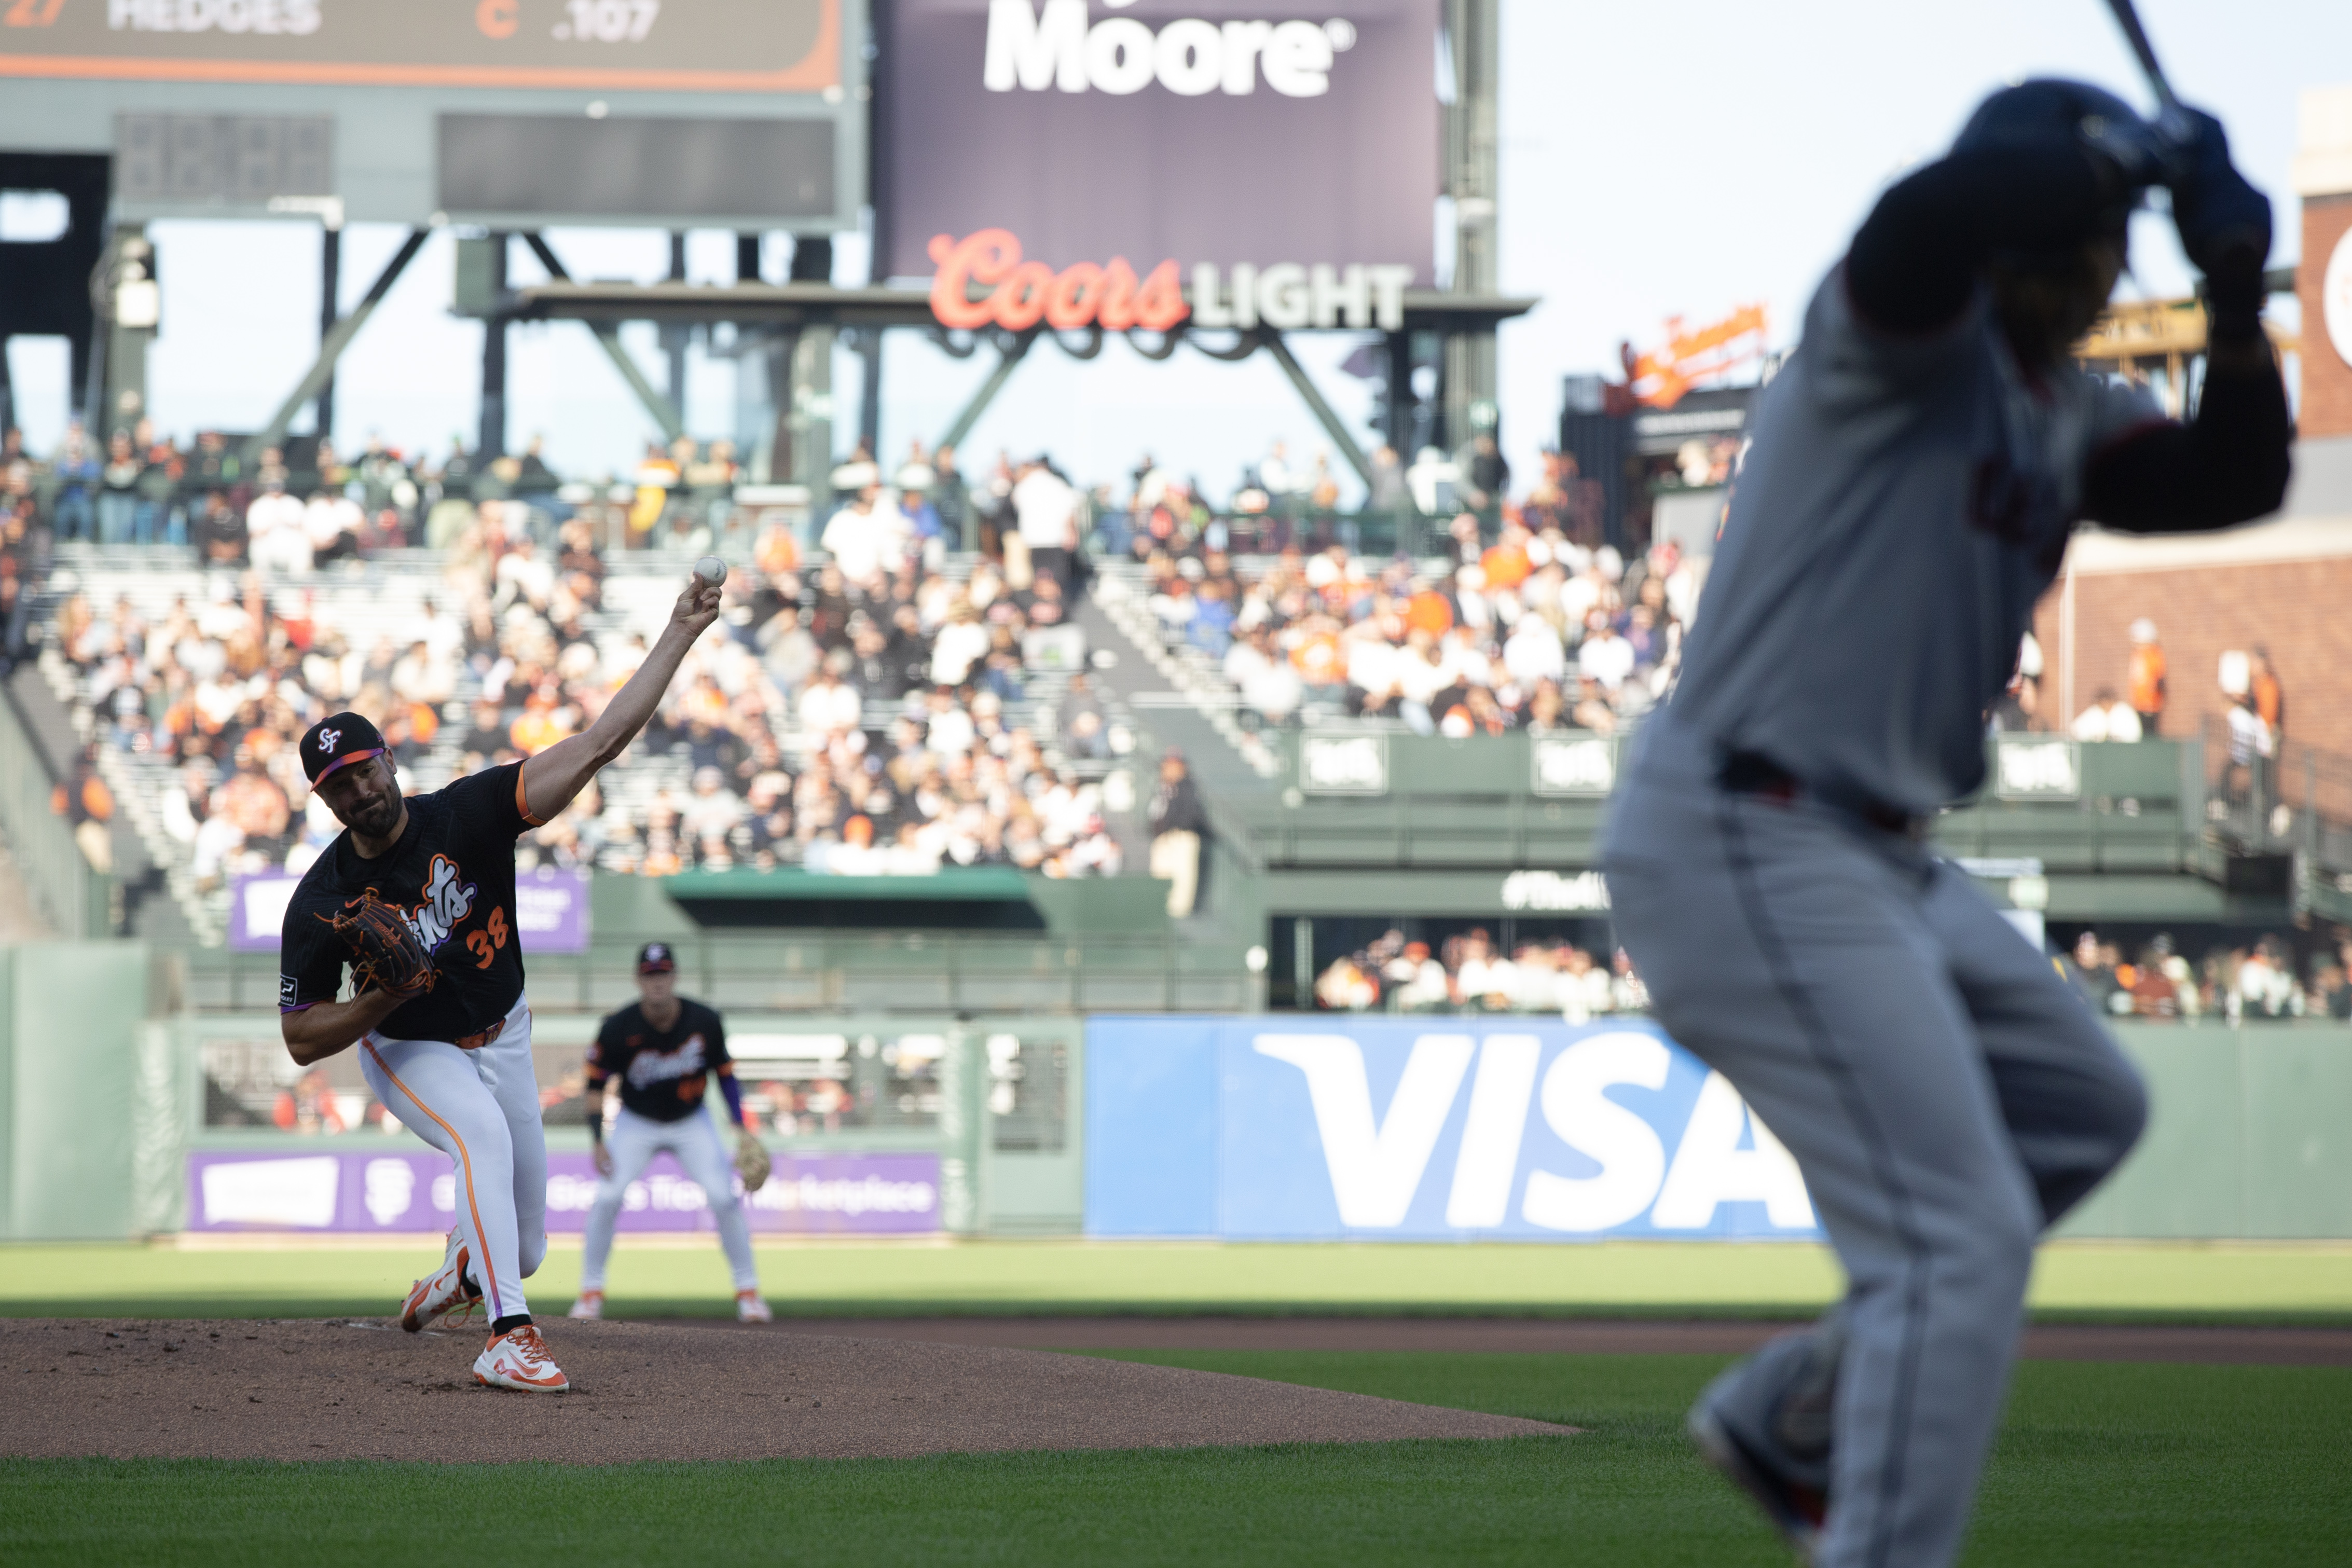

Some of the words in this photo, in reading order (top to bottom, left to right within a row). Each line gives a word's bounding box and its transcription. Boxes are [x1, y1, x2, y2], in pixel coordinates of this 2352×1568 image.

[107, 0, 322, 35] HEDGES
[551, 0, 661, 42] .107
[928, 228, 1191, 331] Coors
[1192, 262, 1414, 331] LIGHT
[319, 728, 342, 754] SF
[466, 906, 508, 969] 38
[1253, 1032, 1817, 1232] VISA
